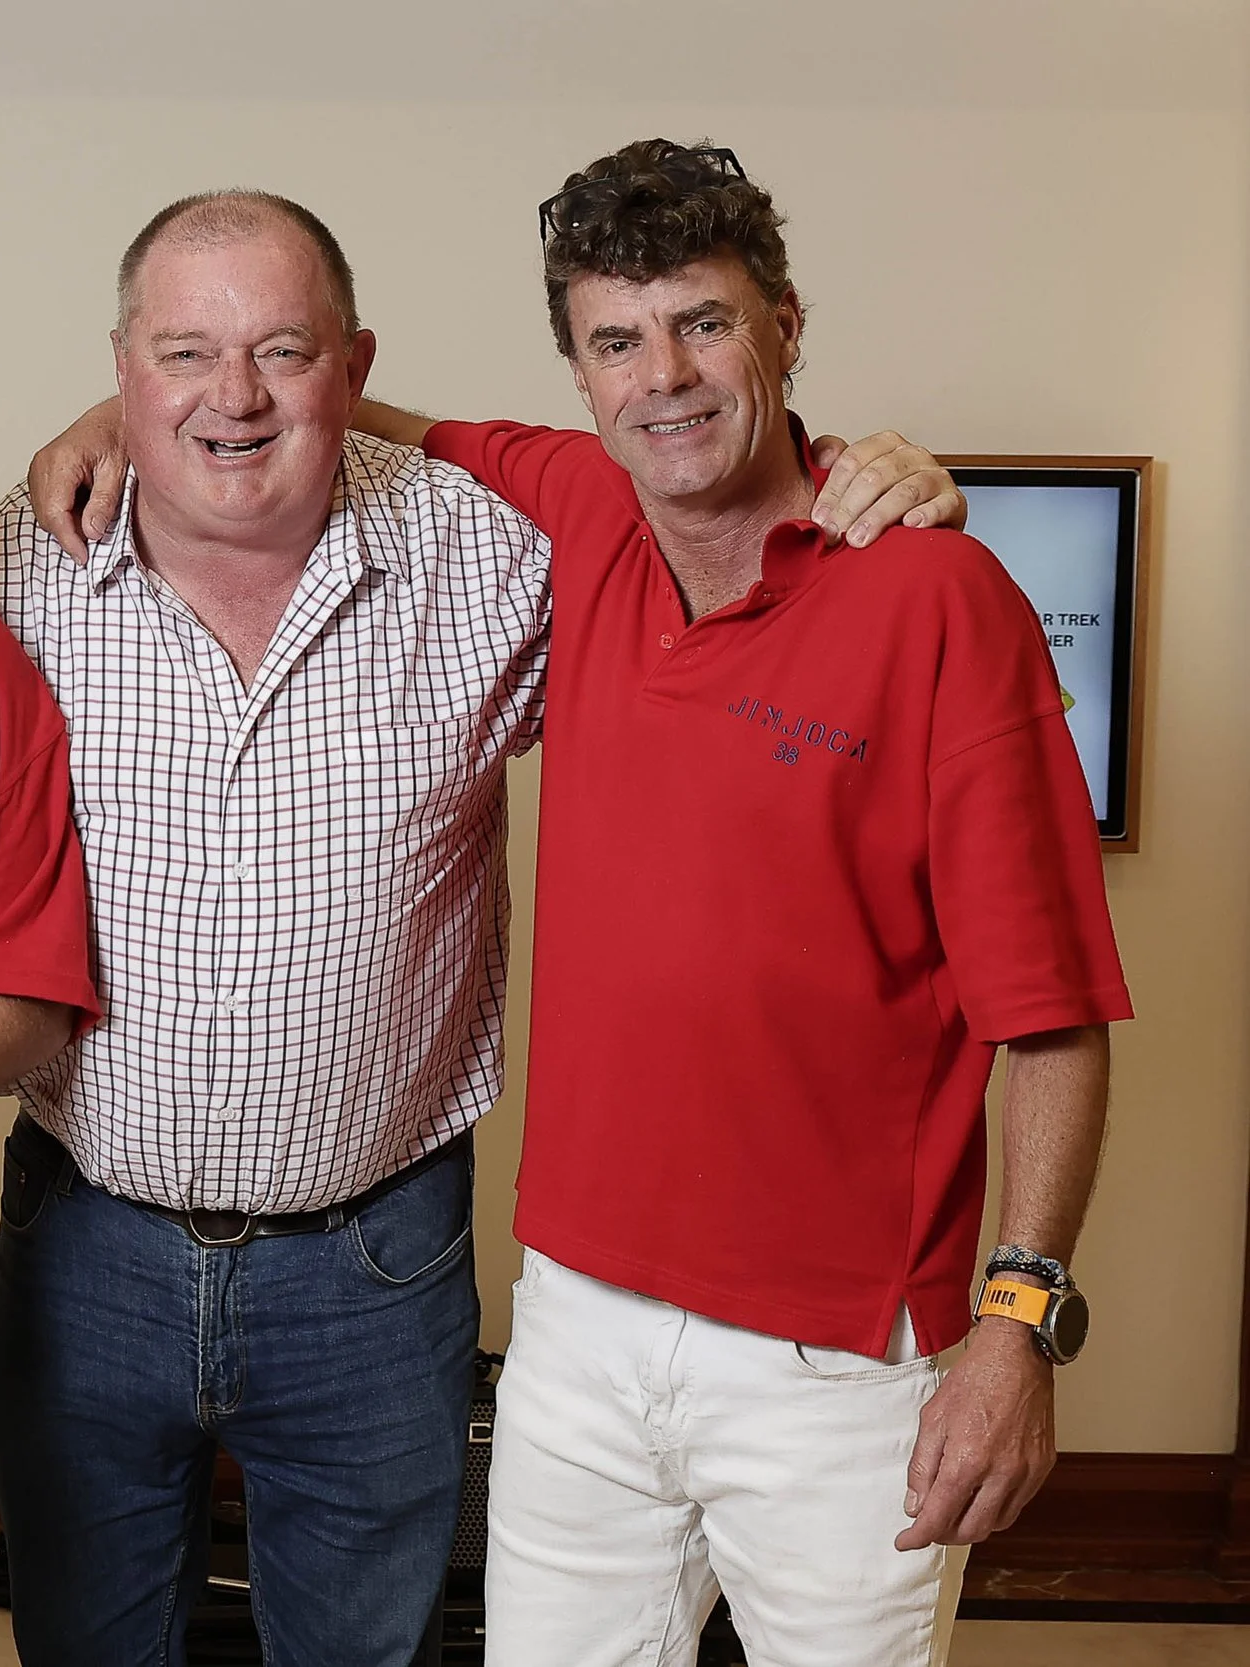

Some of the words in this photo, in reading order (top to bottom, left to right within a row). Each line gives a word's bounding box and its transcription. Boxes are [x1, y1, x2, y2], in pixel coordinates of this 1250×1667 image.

[1039, 613, 1054, 626] R
[1057, 613, 1100, 626] TREK
[772, 741, 800, 766] 38
